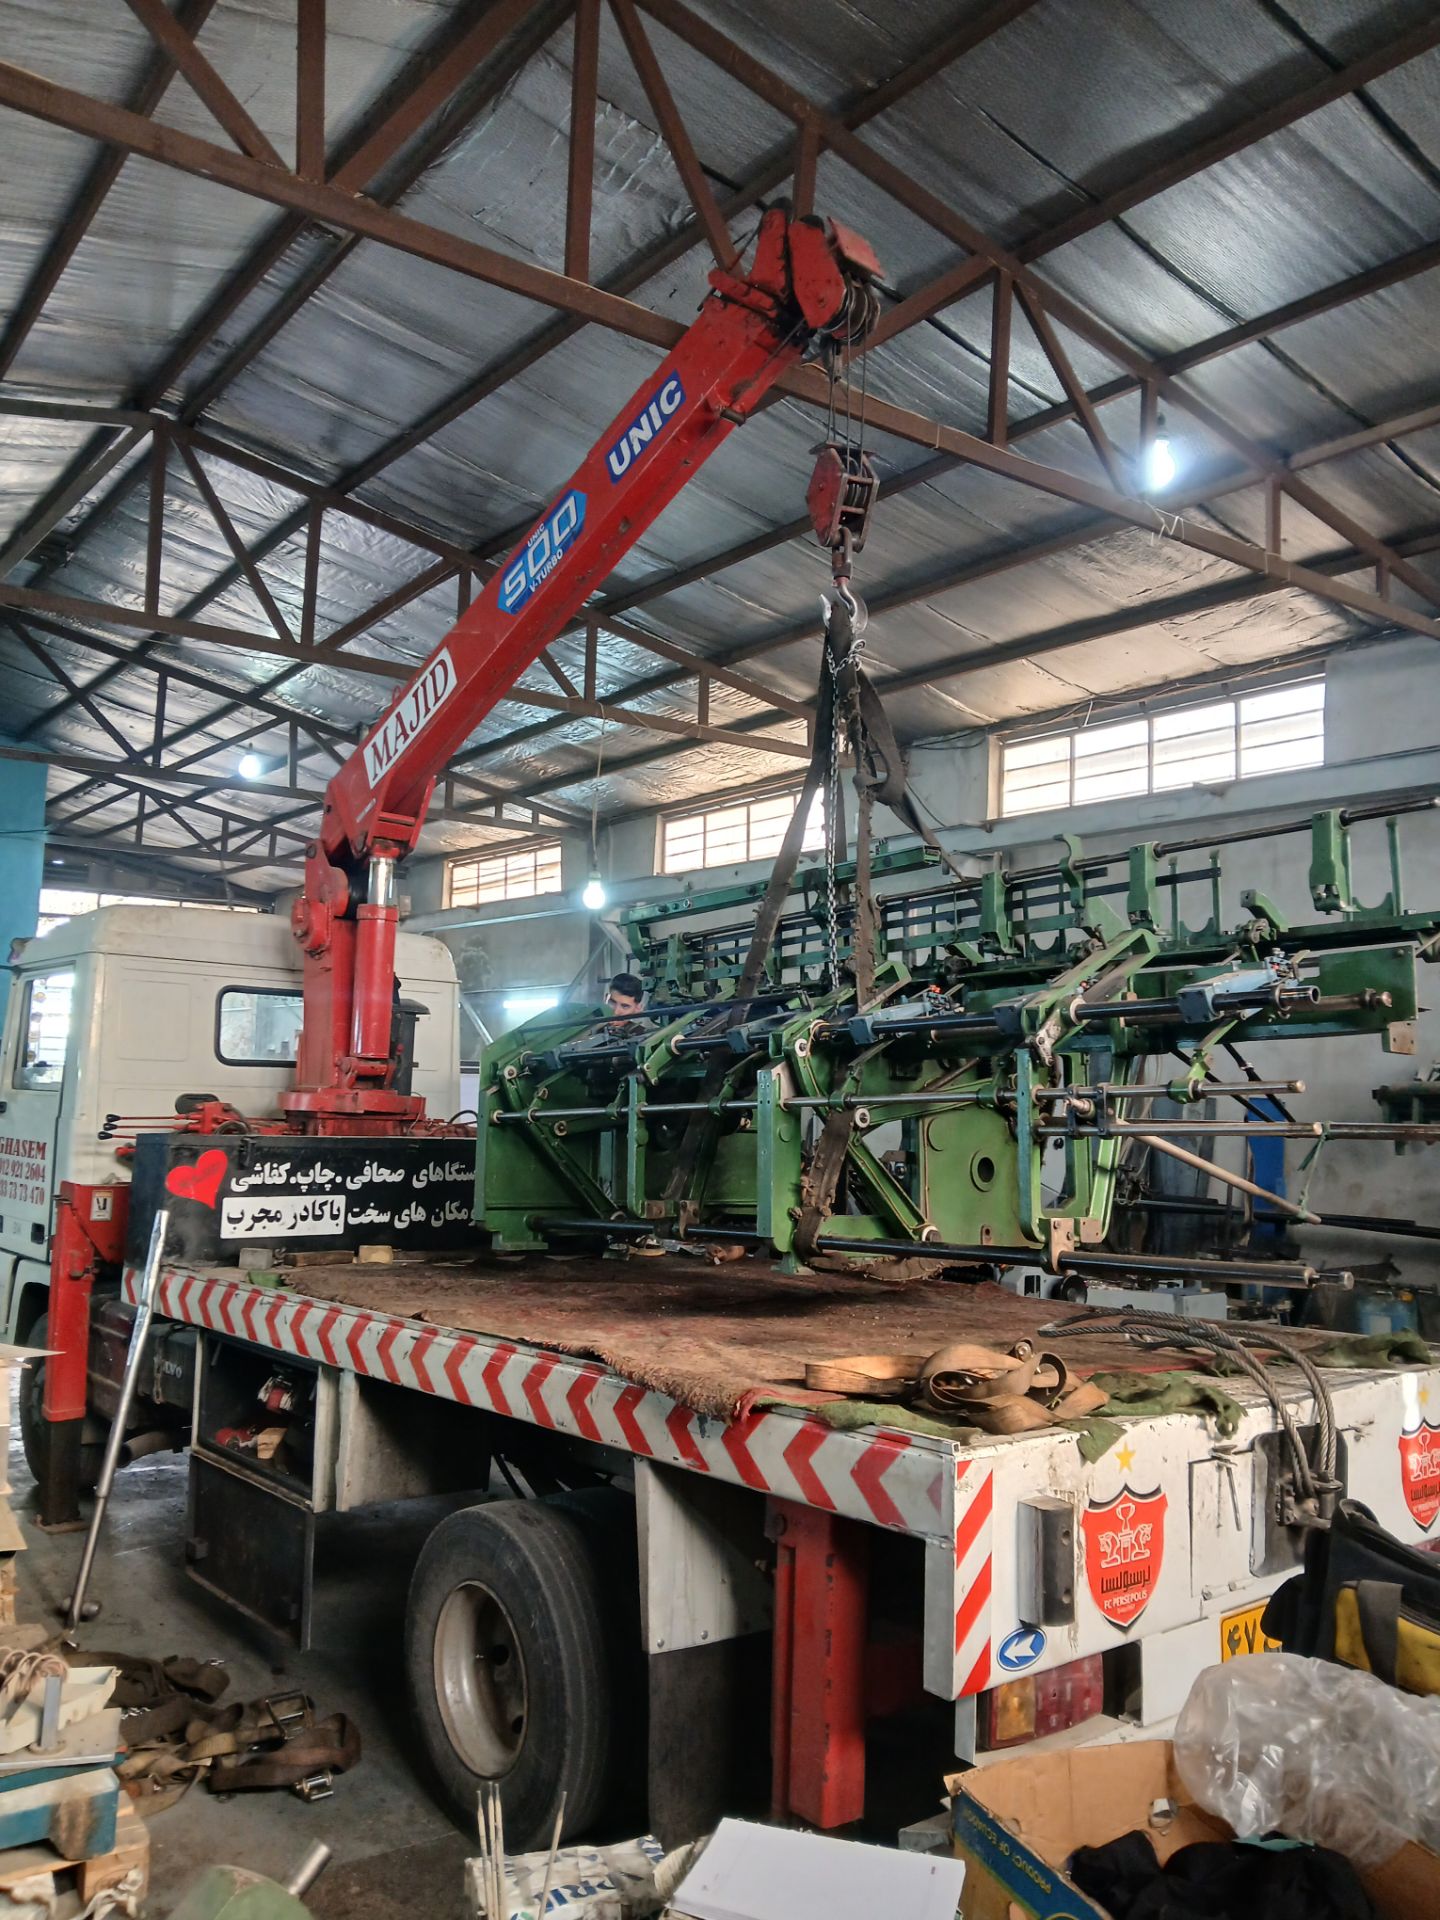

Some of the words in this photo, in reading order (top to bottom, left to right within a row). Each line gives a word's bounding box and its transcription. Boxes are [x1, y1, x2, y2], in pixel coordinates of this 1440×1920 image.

[608, 380, 682, 475] UNIC
[527, 522, 545, 547] UNIC
[504, 496, 577, 607] 500
[529, 548, 563, 593] V-TURBO
[371, 659, 449, 781] MAJID
[0, 1136, 47, 1160] GHASEM
[25, 1161, 46, 1183] 2604
[412, 1160, 475, 1188] ستگاهای
[227, 1208, 282, 1231] مجرب
[347, 1202, 391, 1225] سخت
[394, 1201, 426, 1229] های
[430, 1200, 468, 1227] مکان
